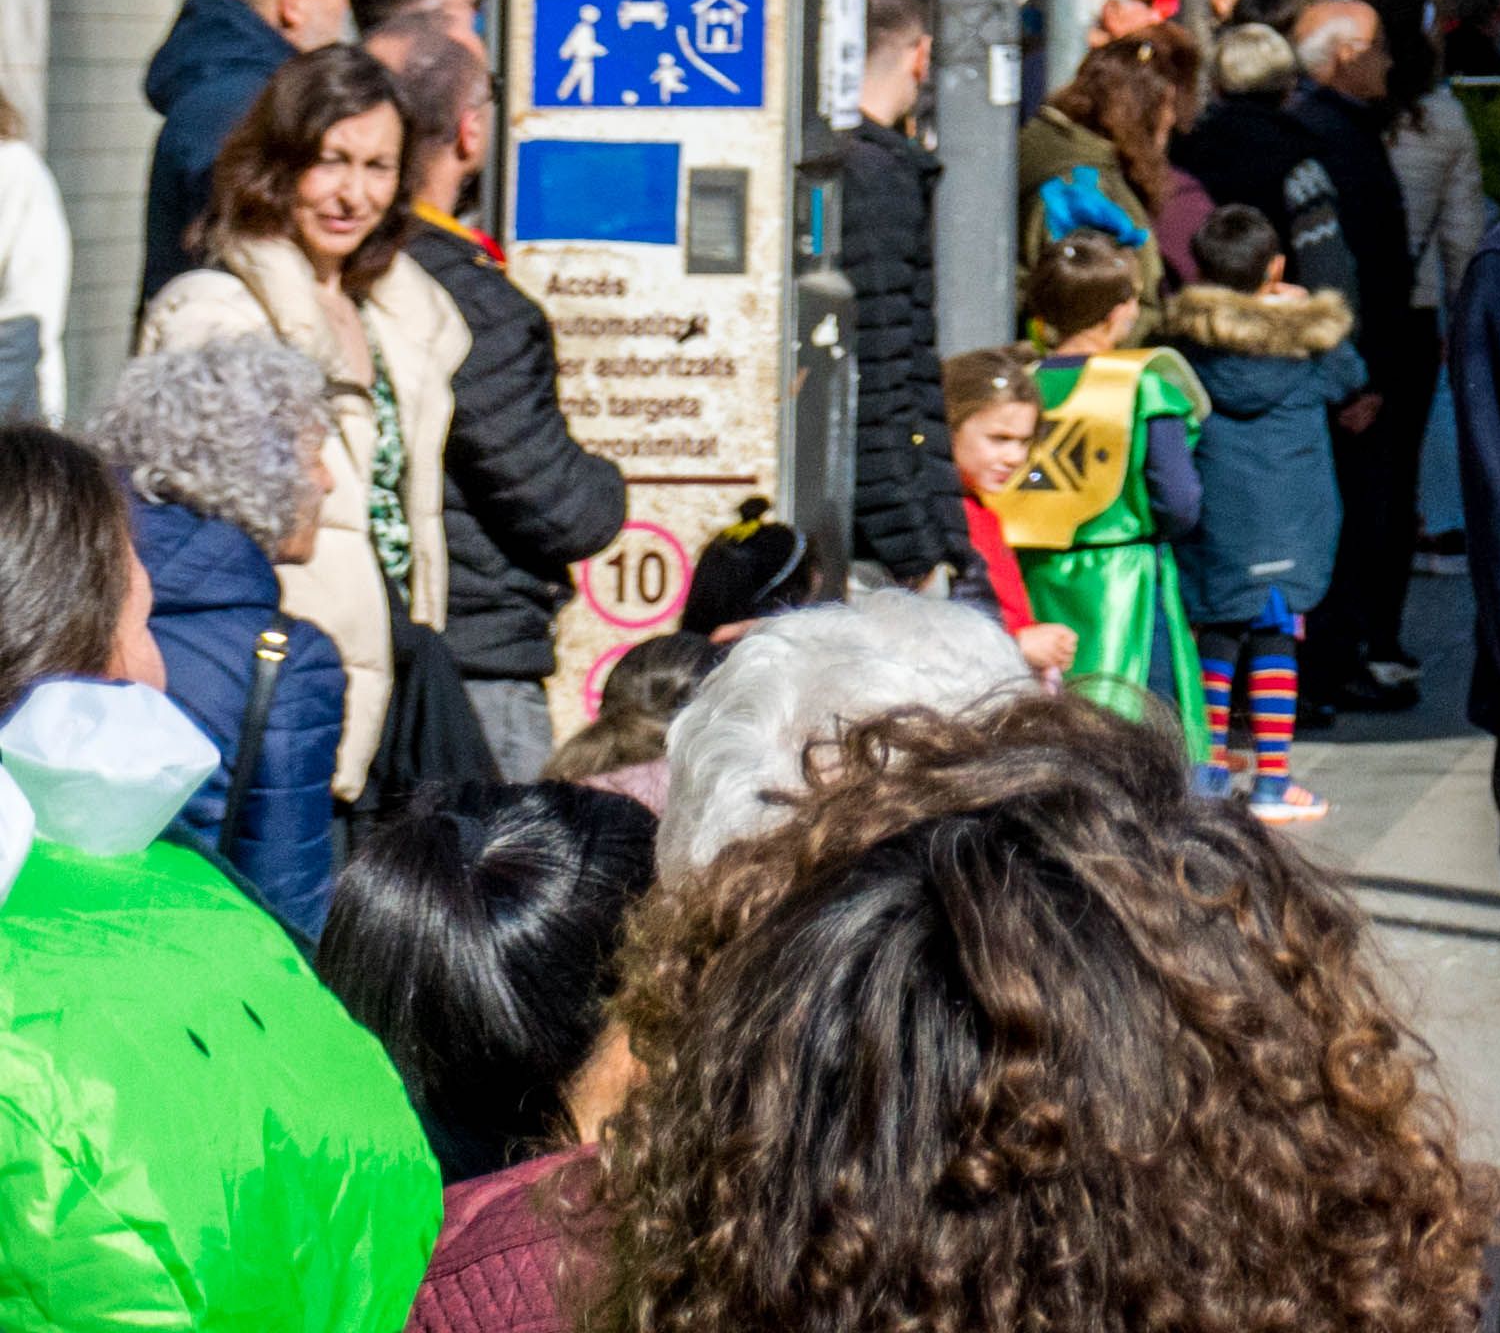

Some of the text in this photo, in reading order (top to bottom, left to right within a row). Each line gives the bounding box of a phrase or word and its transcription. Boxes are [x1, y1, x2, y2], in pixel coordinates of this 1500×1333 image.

[559, 359, 584, 376] er
[562, 396, 701, 422] mb targeta
[607, 550, 667, 606] 10
